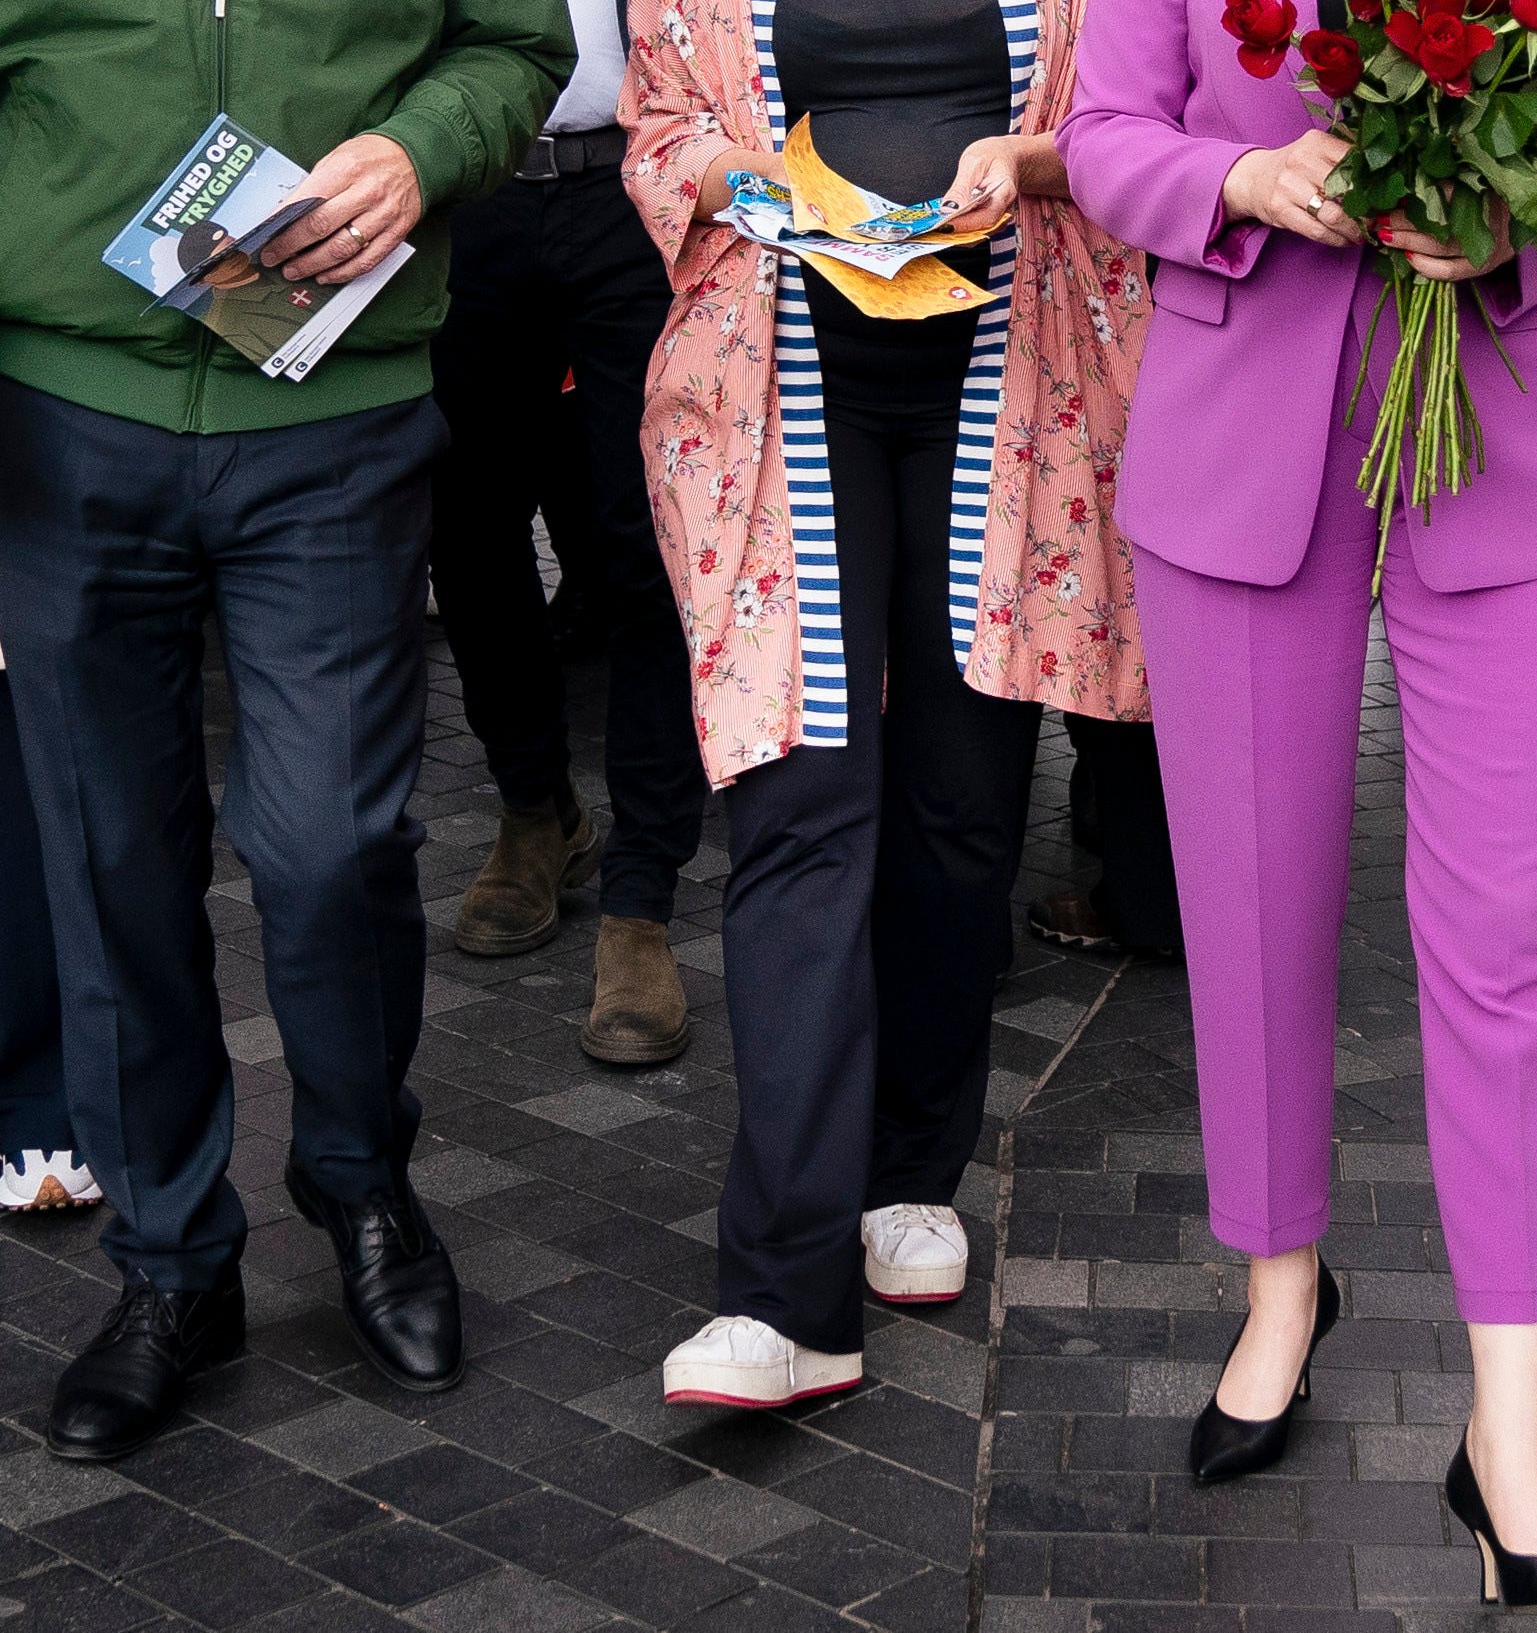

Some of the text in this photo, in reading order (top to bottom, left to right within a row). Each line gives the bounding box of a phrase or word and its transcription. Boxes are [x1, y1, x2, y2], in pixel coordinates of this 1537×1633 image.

[151, 130, 238, 229] FRIHED OG
[178, 144, 254, 226] TRYGHED
